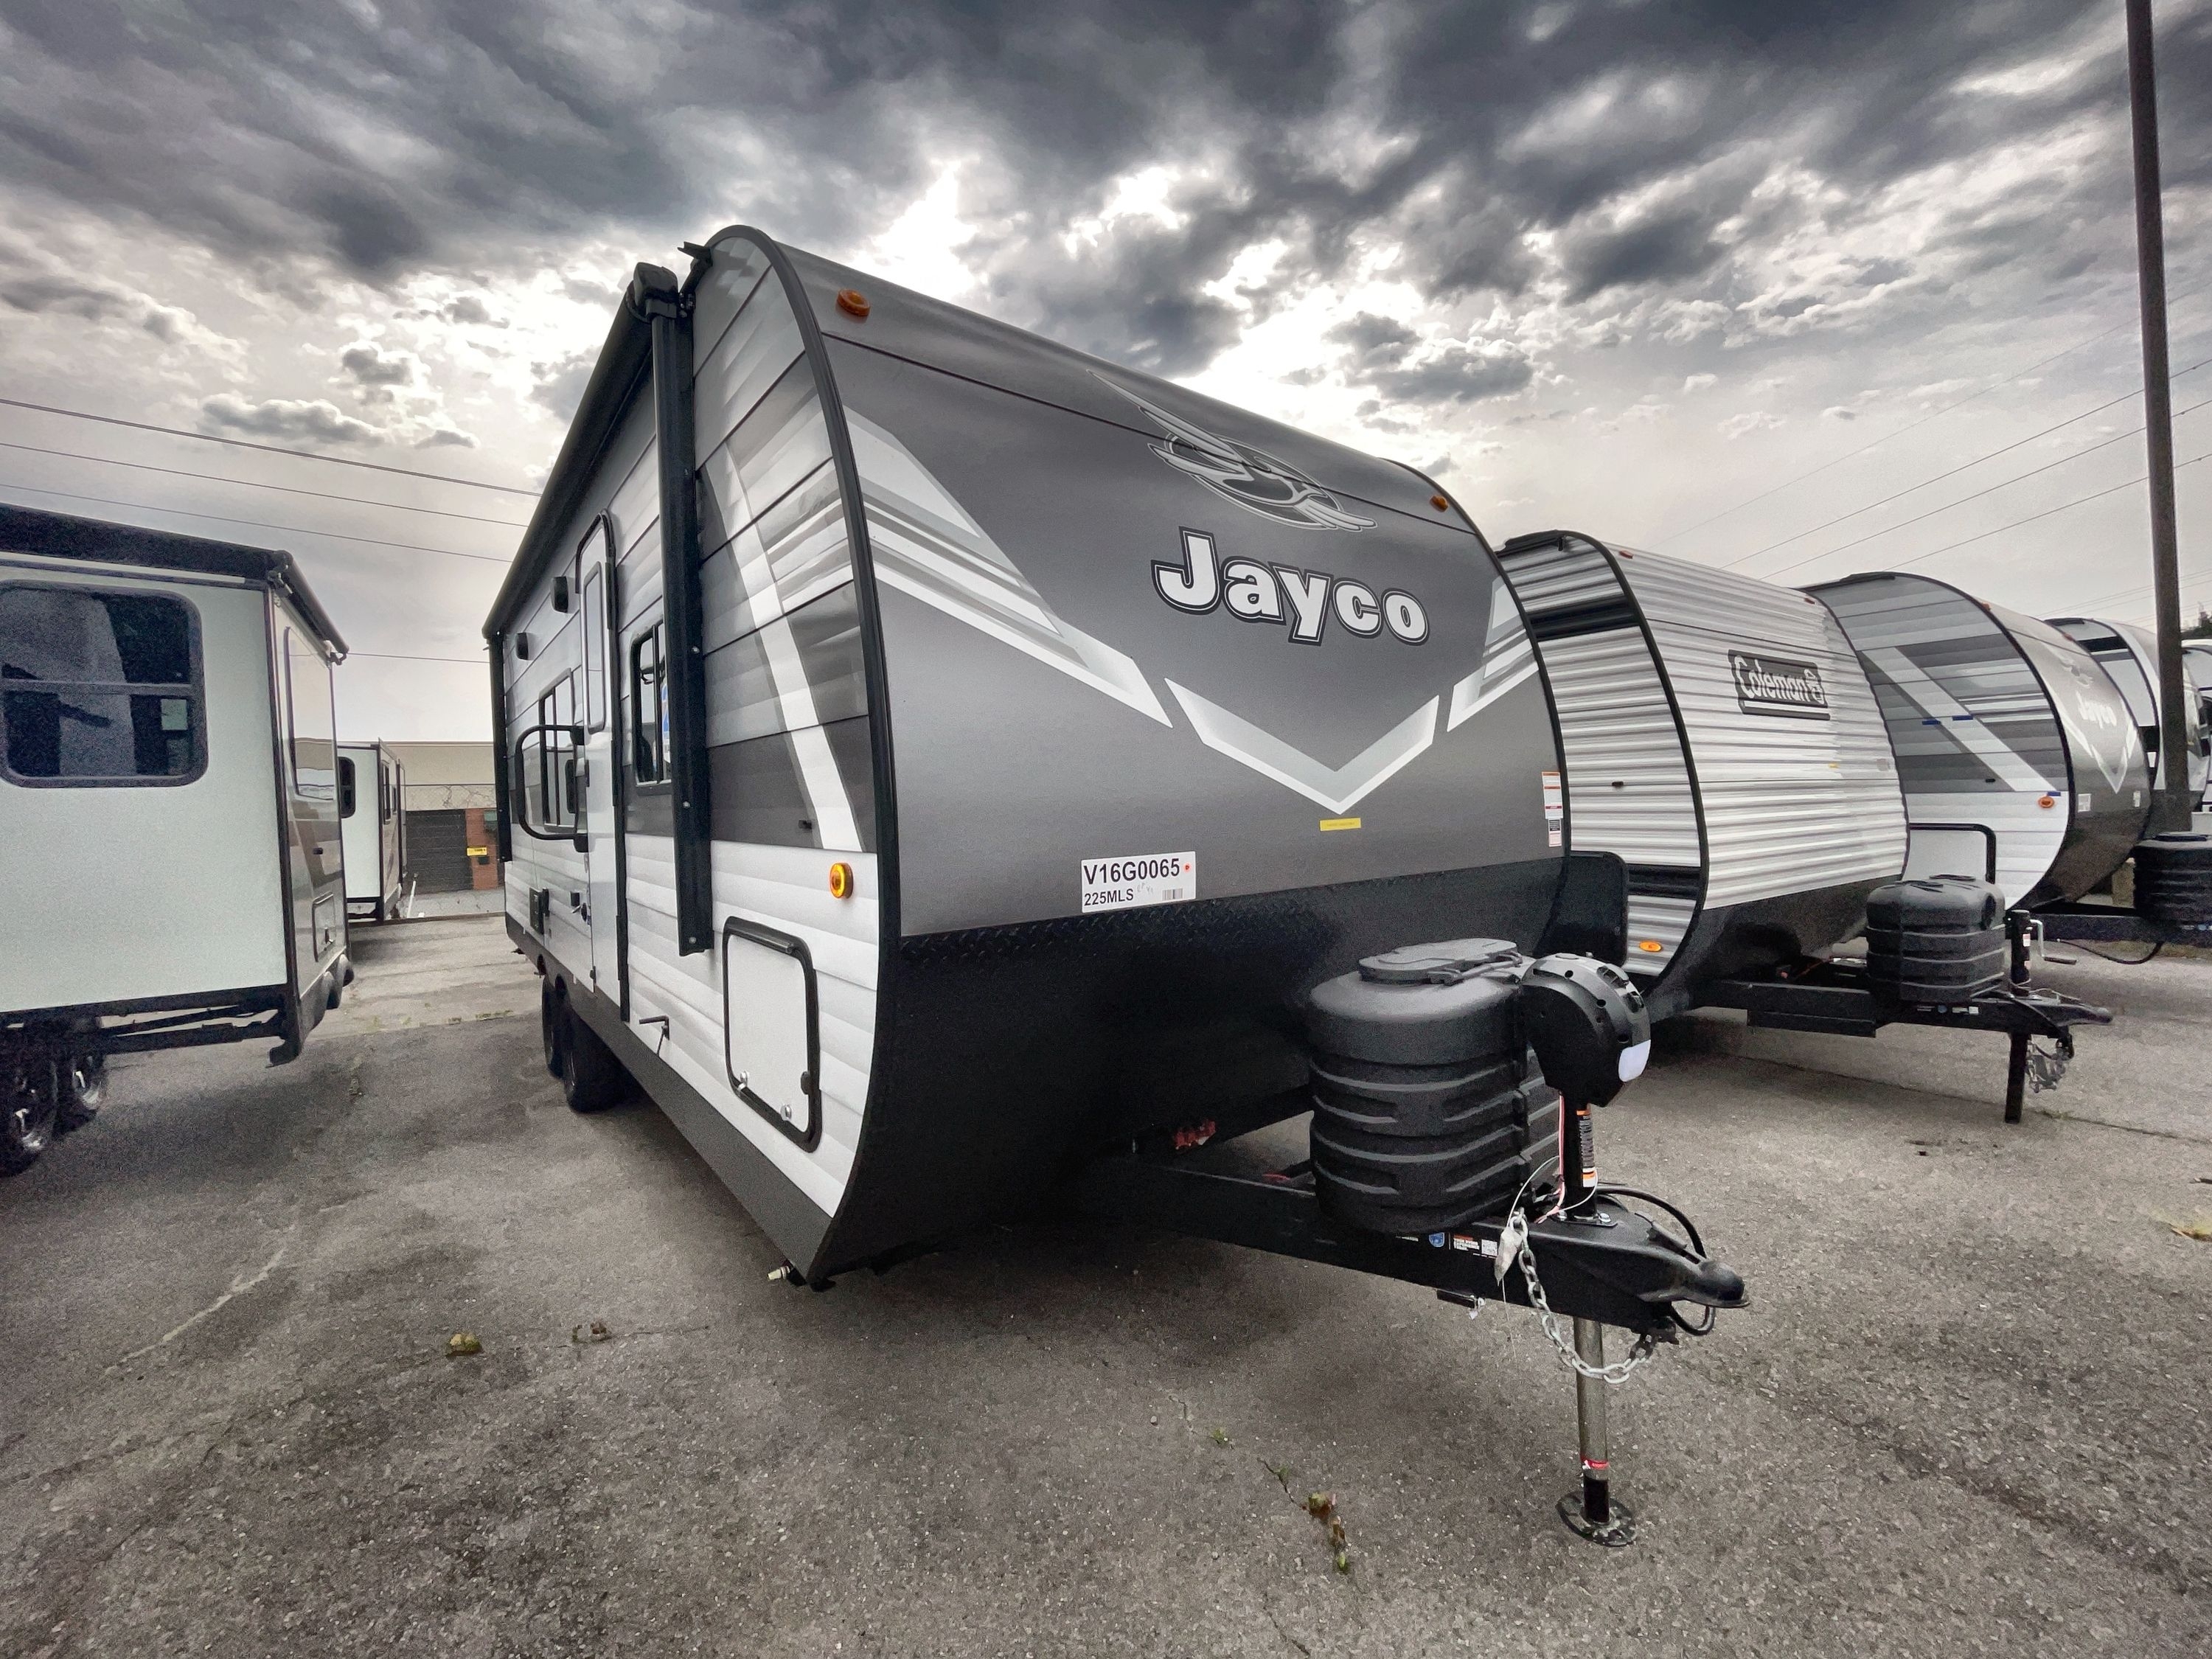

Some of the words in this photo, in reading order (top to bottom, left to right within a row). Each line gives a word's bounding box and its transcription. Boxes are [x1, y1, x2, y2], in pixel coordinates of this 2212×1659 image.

[1151, 526, 1430, 646] Jayco
[1734, 655, 1810, 702] Coleman
[1084, 858, 1180, 885] V16G0065
[1084, 888, 1134, 906] 225MLS
